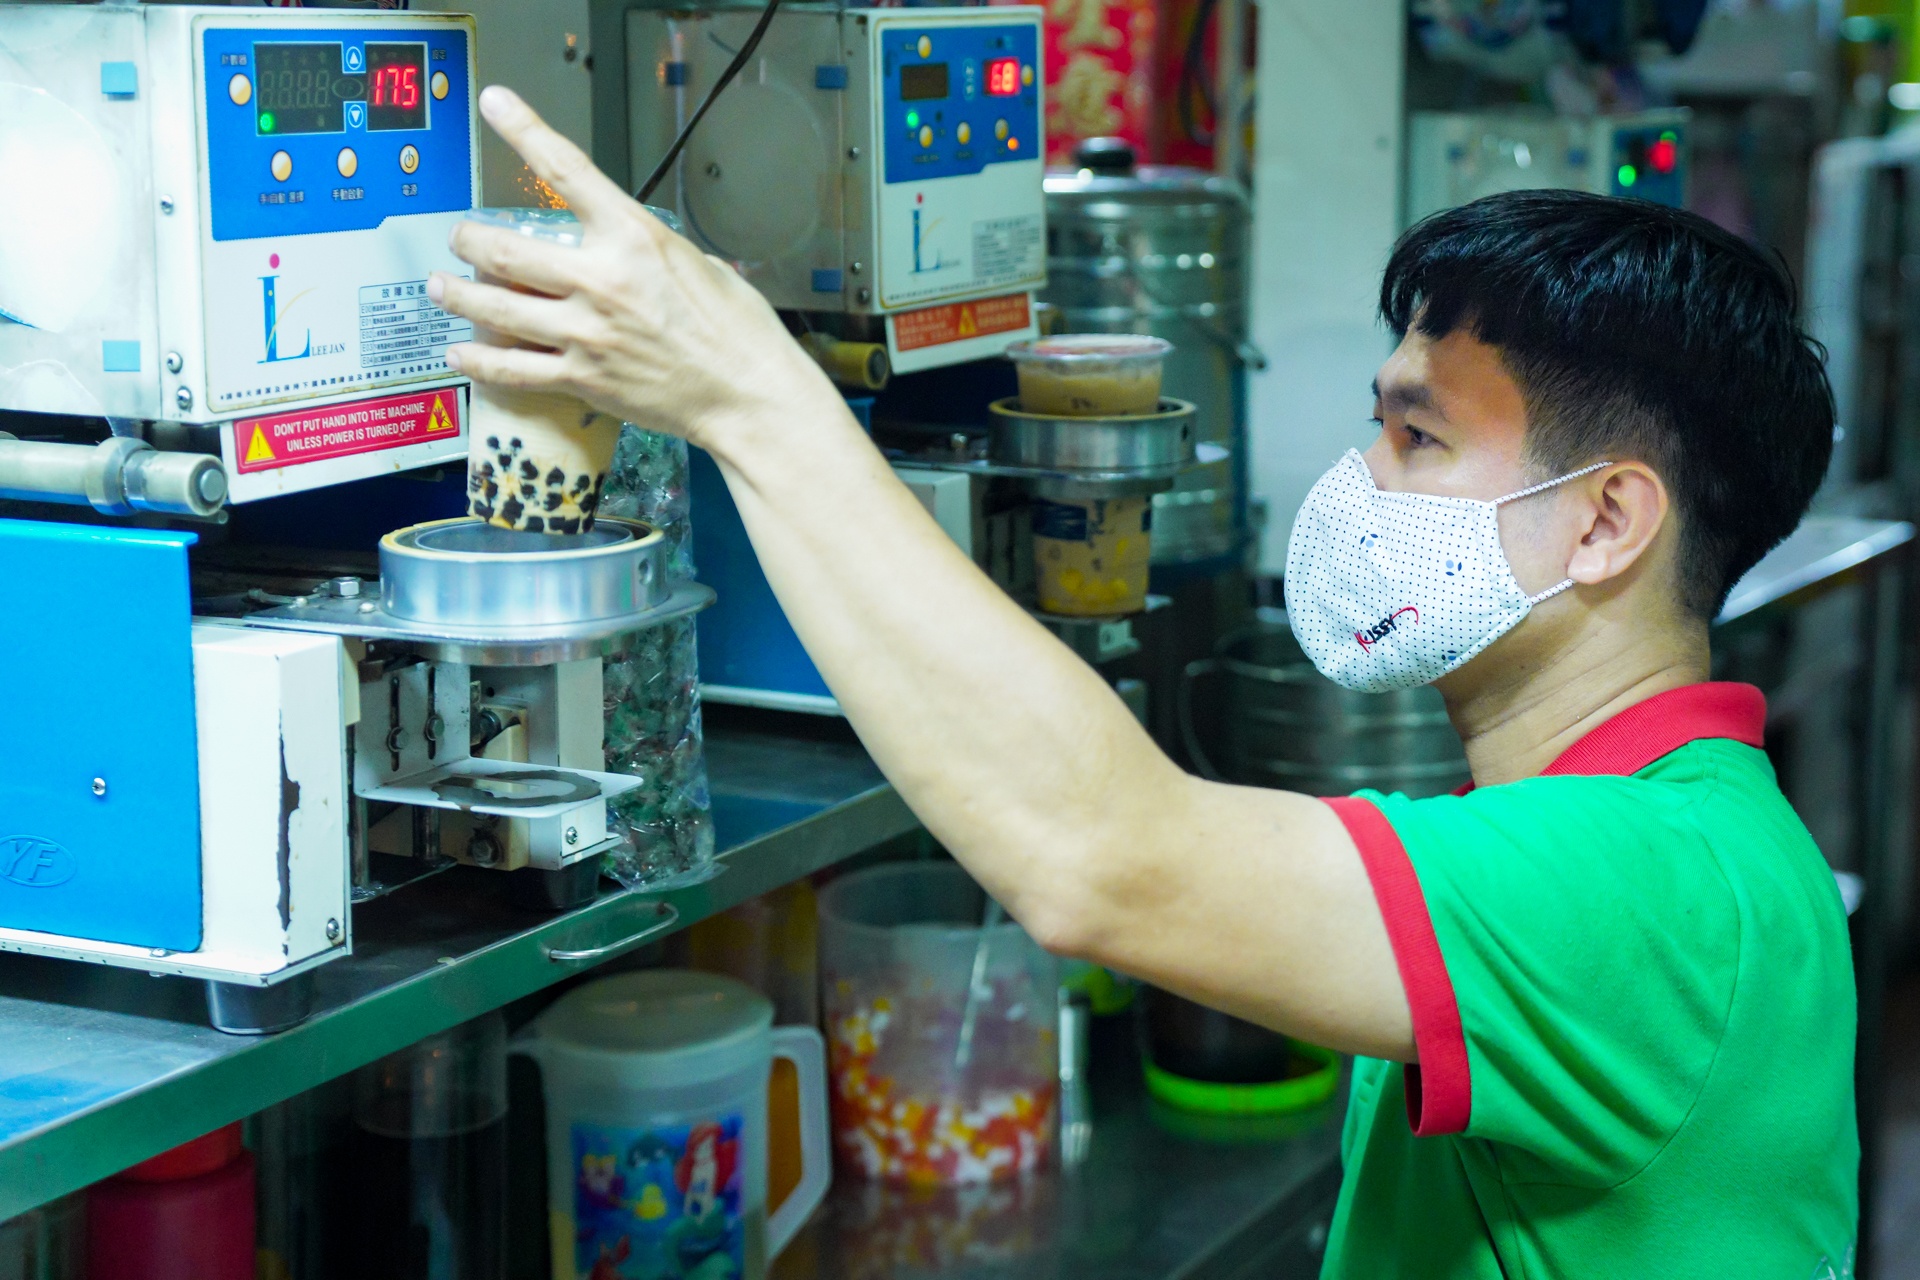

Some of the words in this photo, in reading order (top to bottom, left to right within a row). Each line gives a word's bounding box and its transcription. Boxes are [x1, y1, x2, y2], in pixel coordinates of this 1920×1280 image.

[374, 67, 418, 106] 175
[311, 345, 328, 357] LEE
[329, 343, 345, 355] JAN
[273, 420, 301, 437] DON'T
[302, 418, 320, 433] PUT
[322, 415, 346, 429] HAND
[348, 411, 368, 425] INTO
[369, 408, 386, 421] THE
[387, 402, 425, 418] MACHINE
[286, 435, 322, 452] UNLESS
[323, 430, 355, 446] POWER
[356, 428, 364, 441] IS
[365, 423, 399, 439] TURNED
[400, 420, 416, 433] OFF
